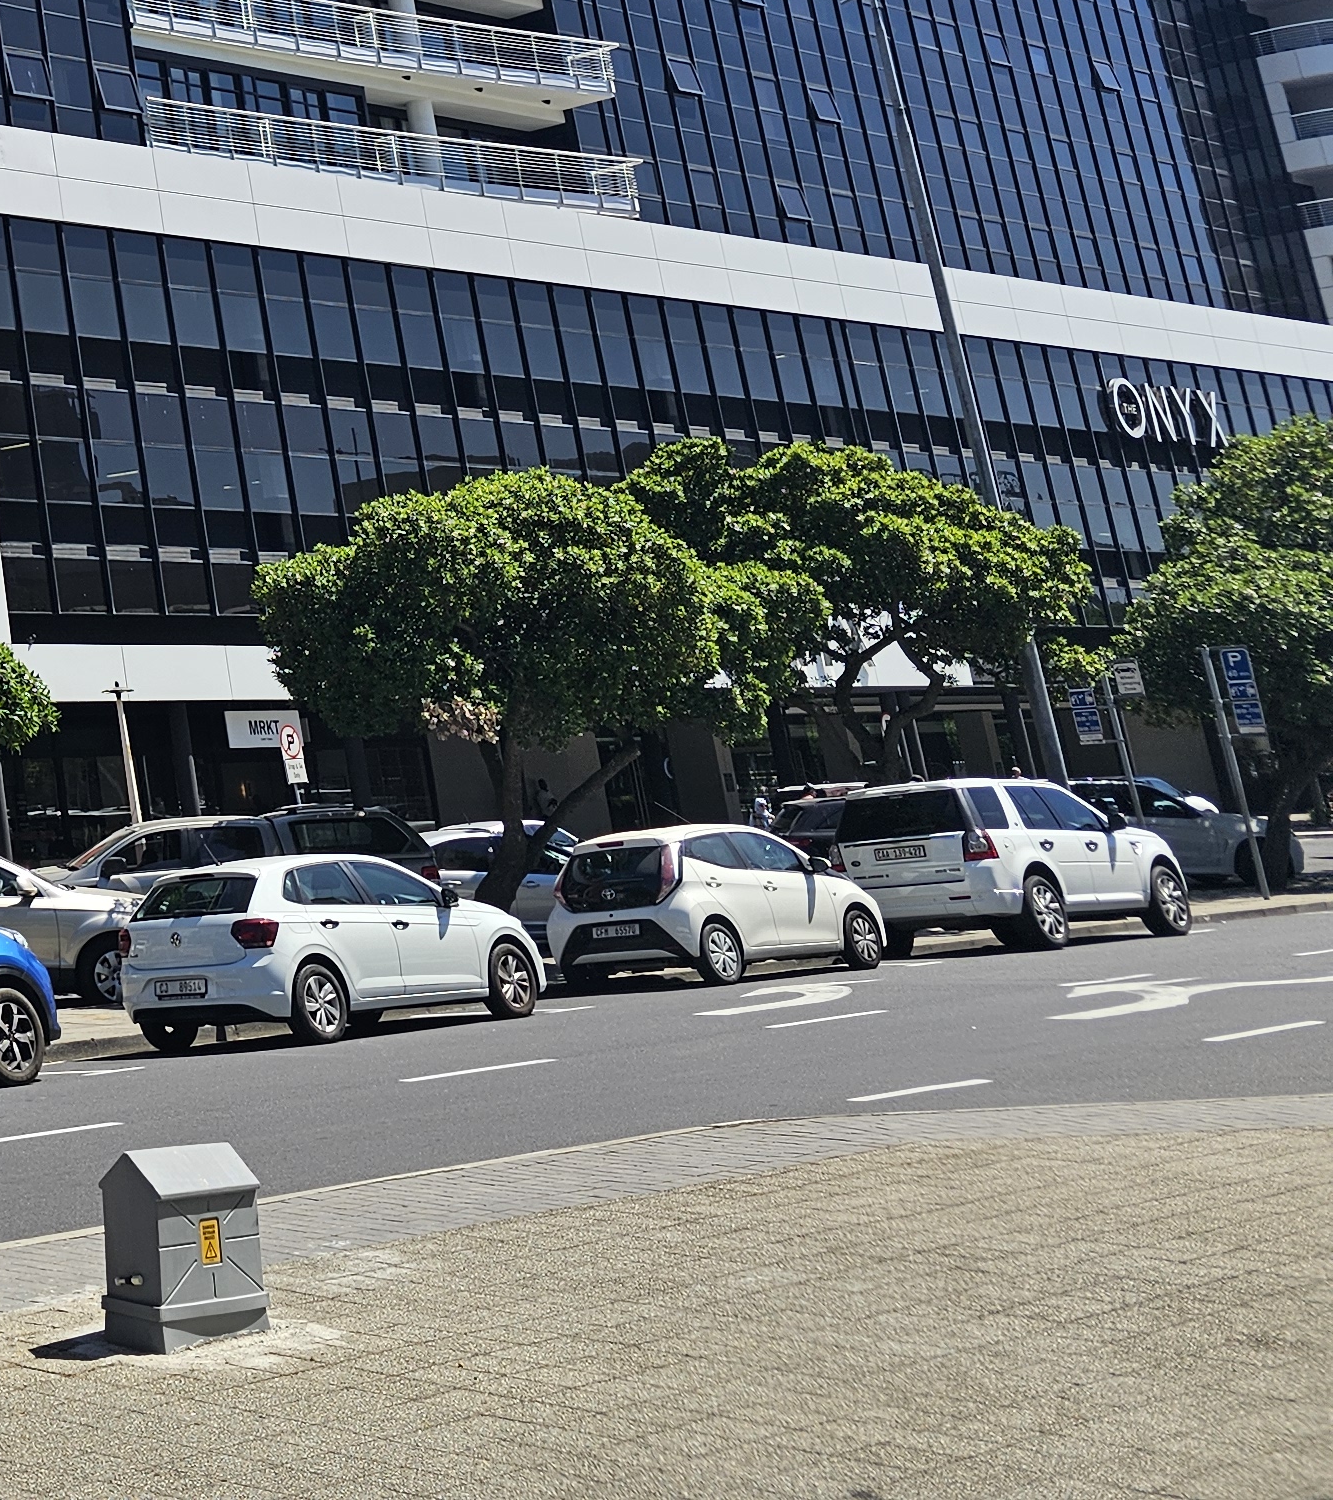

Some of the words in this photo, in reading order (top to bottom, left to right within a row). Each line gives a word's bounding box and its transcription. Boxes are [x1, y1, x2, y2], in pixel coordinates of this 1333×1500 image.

[1109, 377, 1229, 448] ONYX
[1122, 402, 1138, 415] THE
[248, 720, 280, 736] MRKT
[159, 982, 169, 994] CJ
